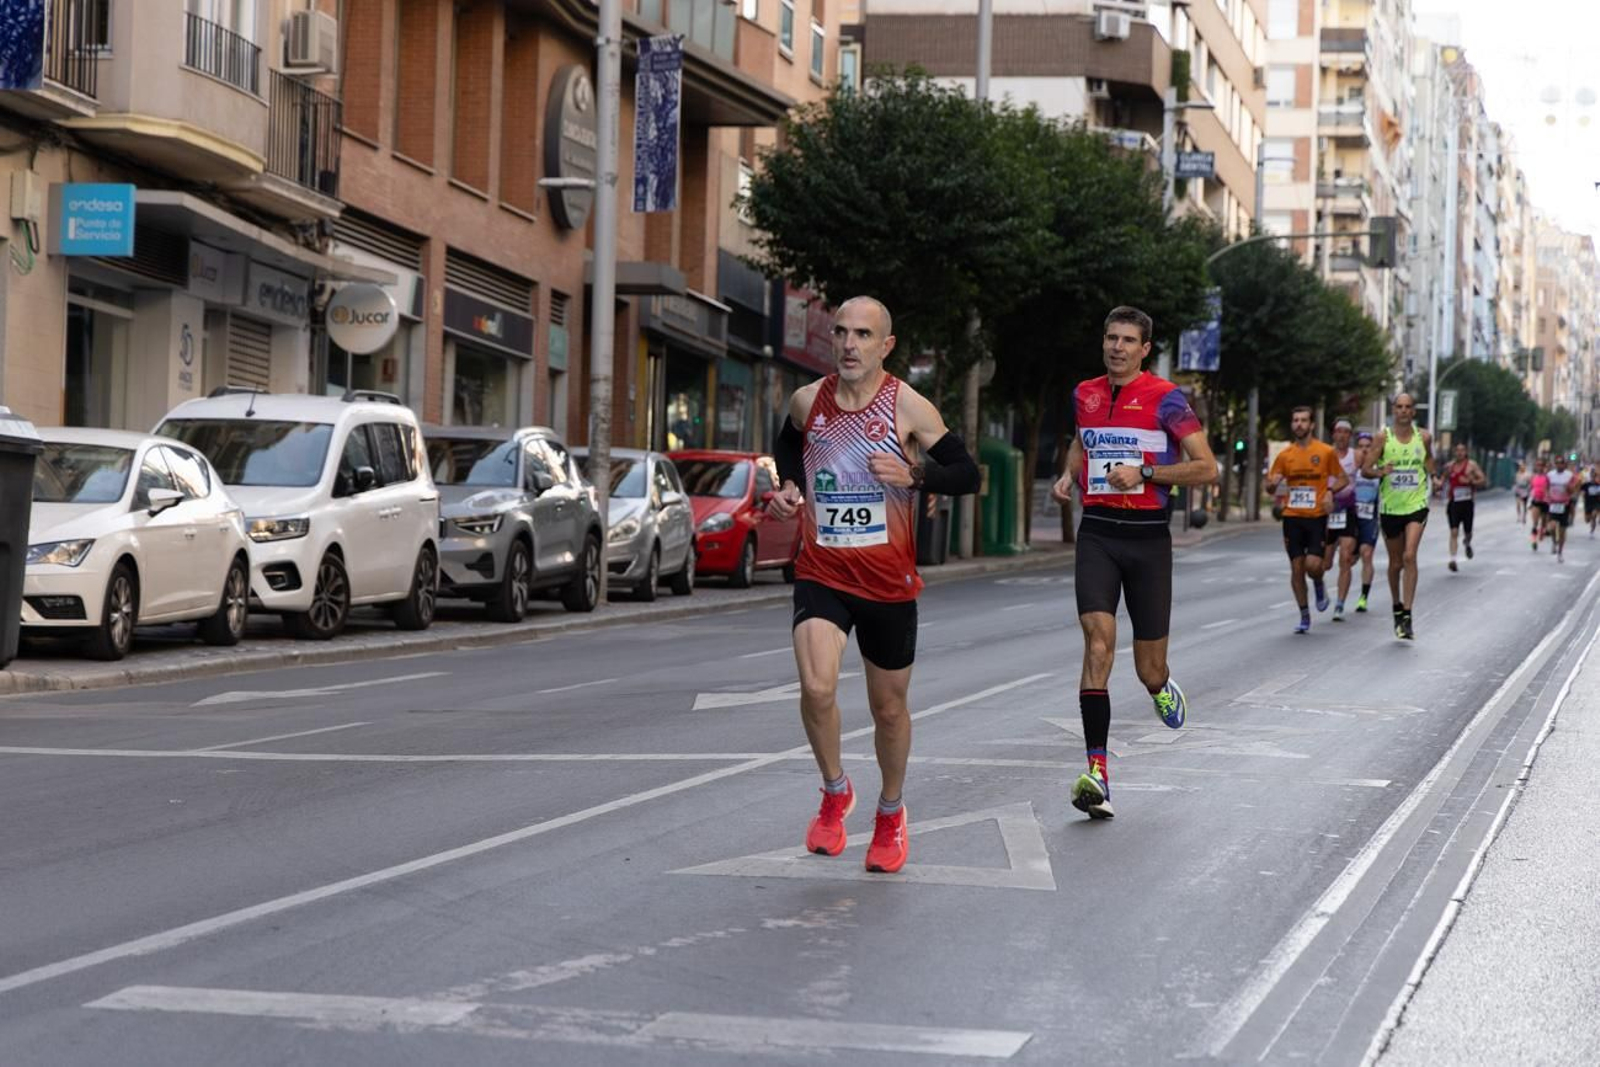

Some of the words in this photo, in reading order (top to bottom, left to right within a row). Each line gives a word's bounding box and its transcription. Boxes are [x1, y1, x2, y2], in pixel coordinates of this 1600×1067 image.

[69, 199, 123, 212] endesa
[349, 309, 390, 325] Jucar
[1098, 433, 1137, 445] Avanza
[1395, 475, 1414, 483] 493
[826, 507, 872, 526] 749
